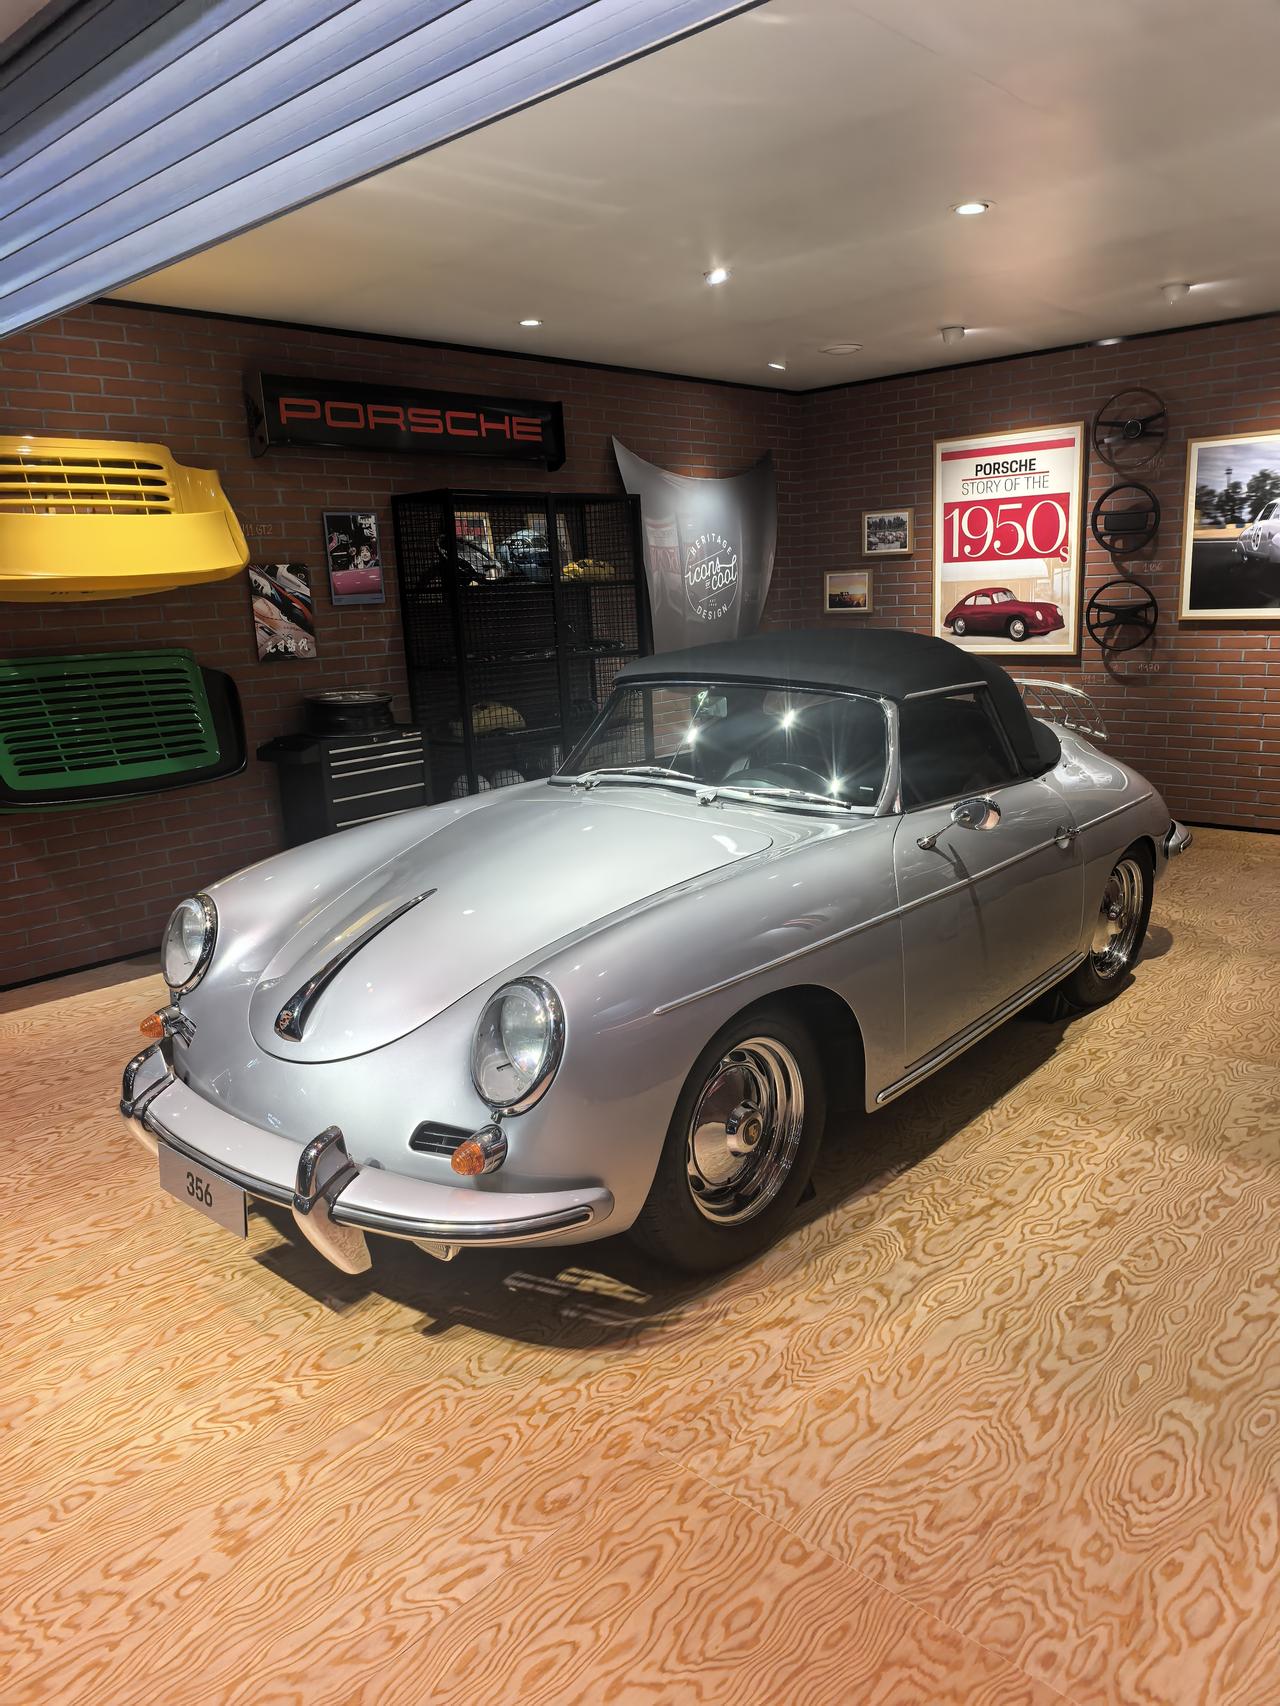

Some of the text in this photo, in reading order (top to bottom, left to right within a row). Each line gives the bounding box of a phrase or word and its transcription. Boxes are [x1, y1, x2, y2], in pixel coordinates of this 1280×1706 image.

[278, 396, 543, 442] PORSCHE
[975, 458, 1037, 477] PORSCHE
[961, 474, 1050, 496] STORY OF THE
[689, 532, 733, 556] HERITAGE
[944, 500, 1070, 564] 1950s
[684, 556, 721, 586] icons
[711, 554, 738, 591] cool
[696, 604, 728, 620] DESIGN
[186, 1171, 213, 1208] 356
